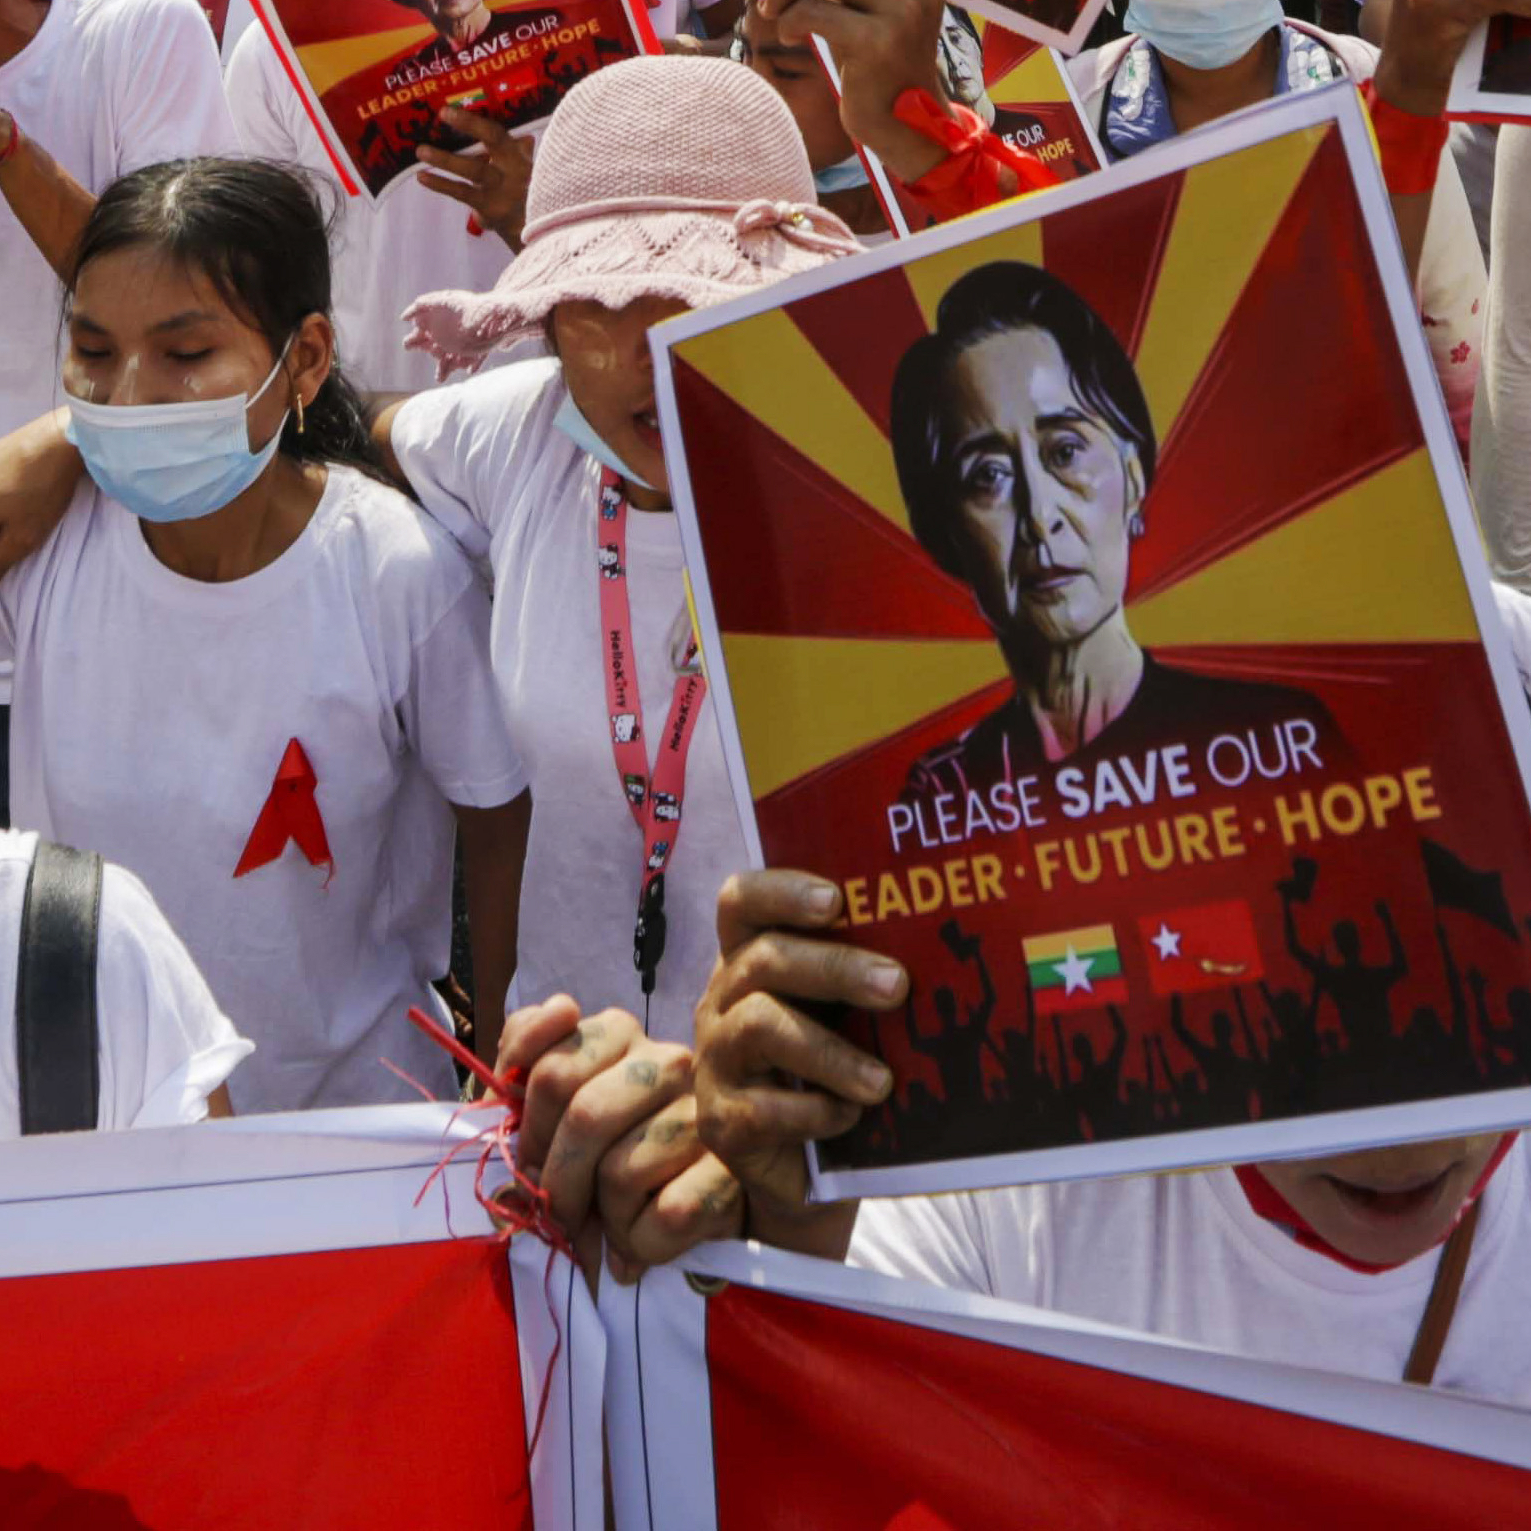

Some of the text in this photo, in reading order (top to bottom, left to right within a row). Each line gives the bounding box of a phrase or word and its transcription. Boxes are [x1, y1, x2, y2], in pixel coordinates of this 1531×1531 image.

[356, 17, 601, 122] LEADER FUTURE HOPE
[384, 13, 560, 93] PLEASE SAVE OUR
[1016, 124, 1045, 147] OUR
[1036, 137, 1075, 163] HOPE
[887, 716, 1324, 855] PLEASE SAVE OUR
[830, 765, 1443, 930] EADER FUTURE HOPE
